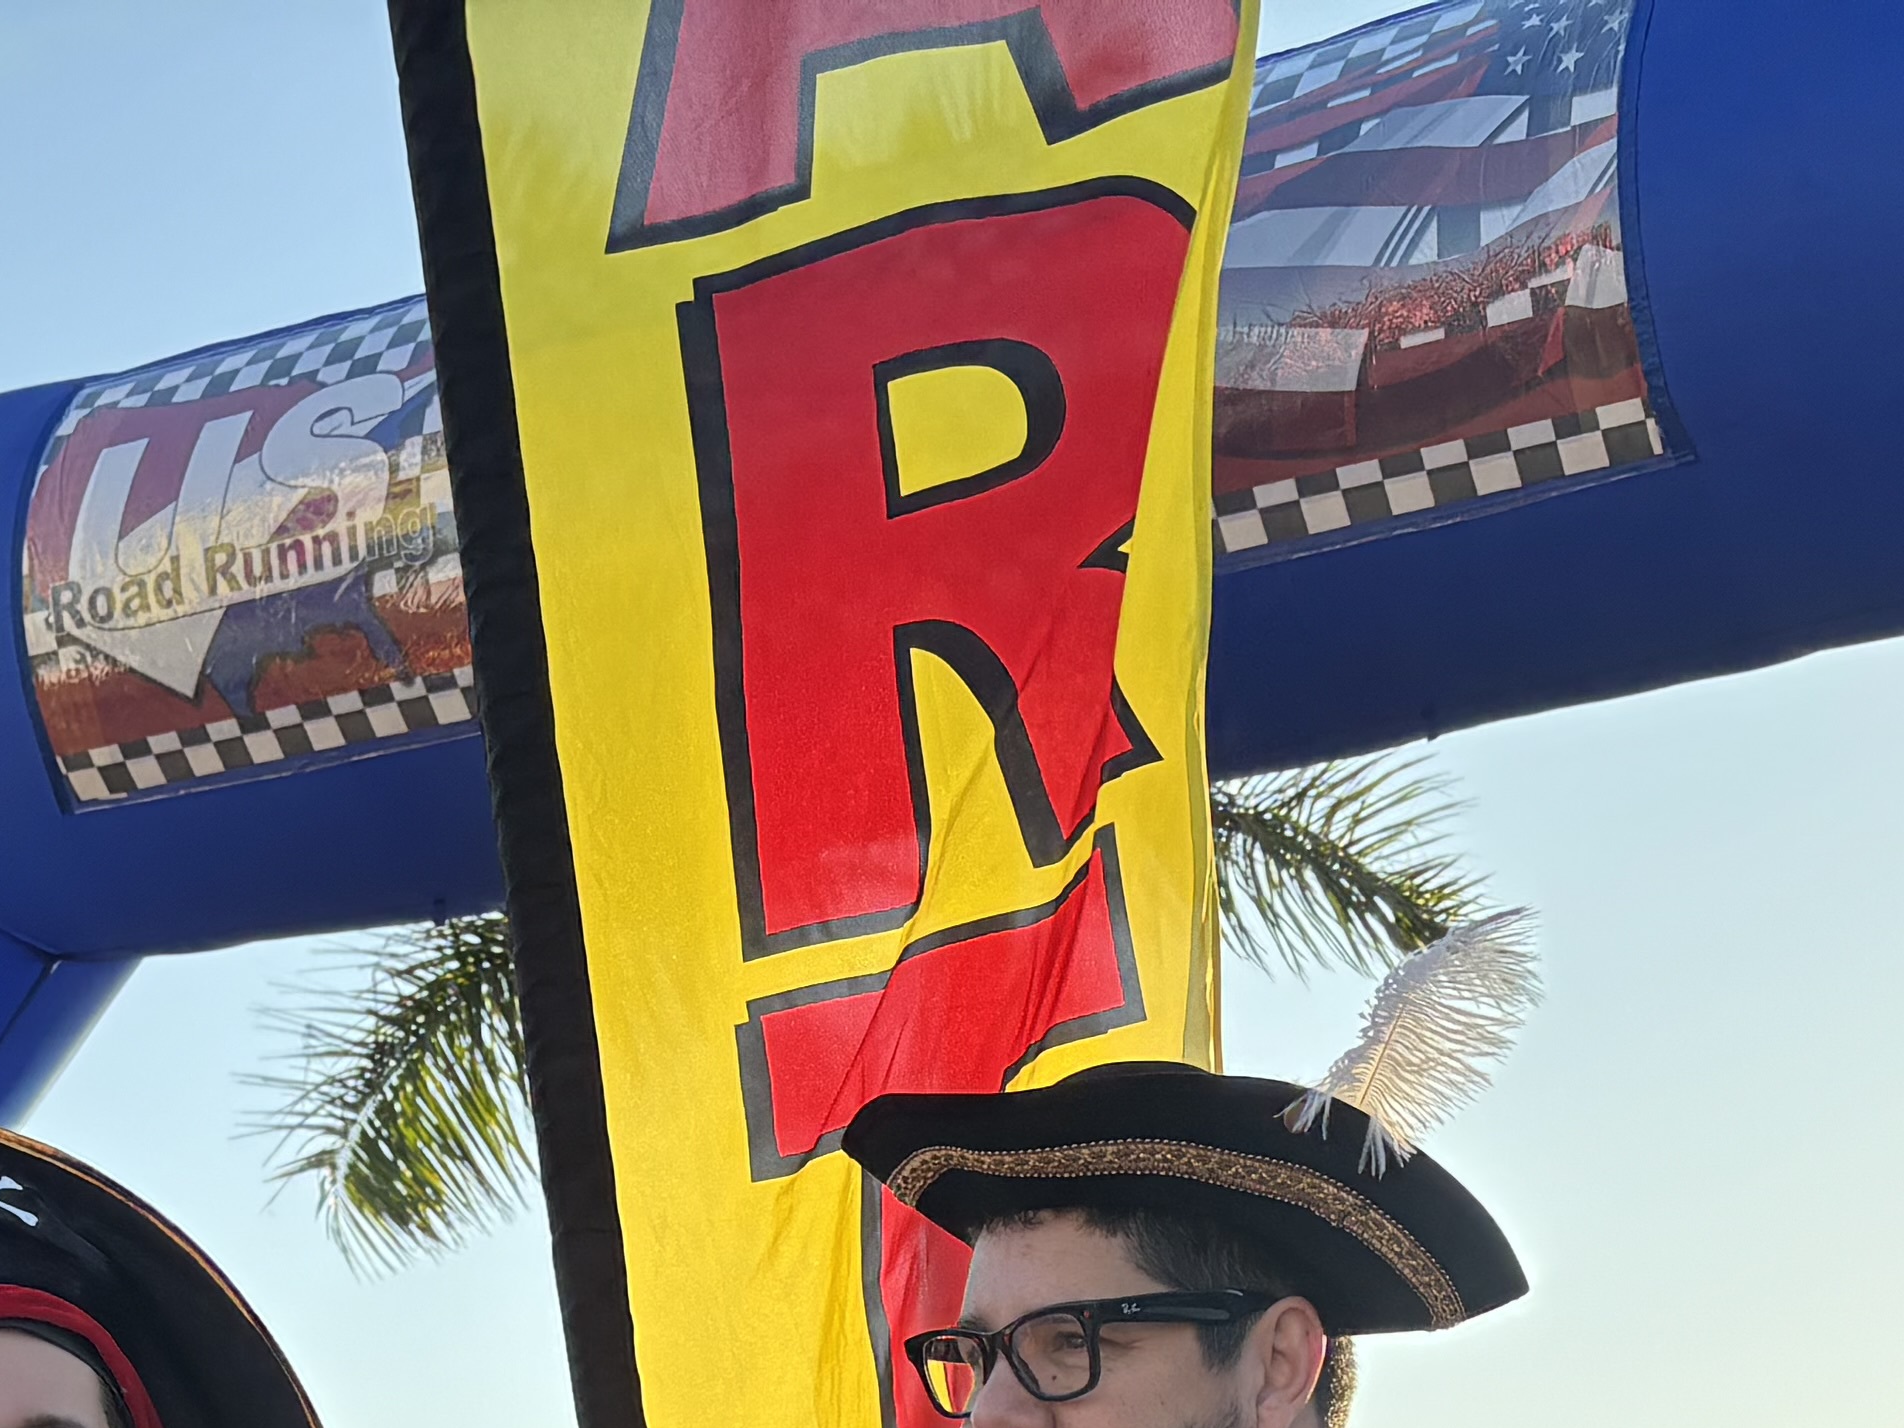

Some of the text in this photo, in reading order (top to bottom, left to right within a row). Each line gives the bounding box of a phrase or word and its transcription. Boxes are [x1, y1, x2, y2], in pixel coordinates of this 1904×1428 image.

[48, 501, 438, 635] Road Running
[68, 370, 405, 600] US
